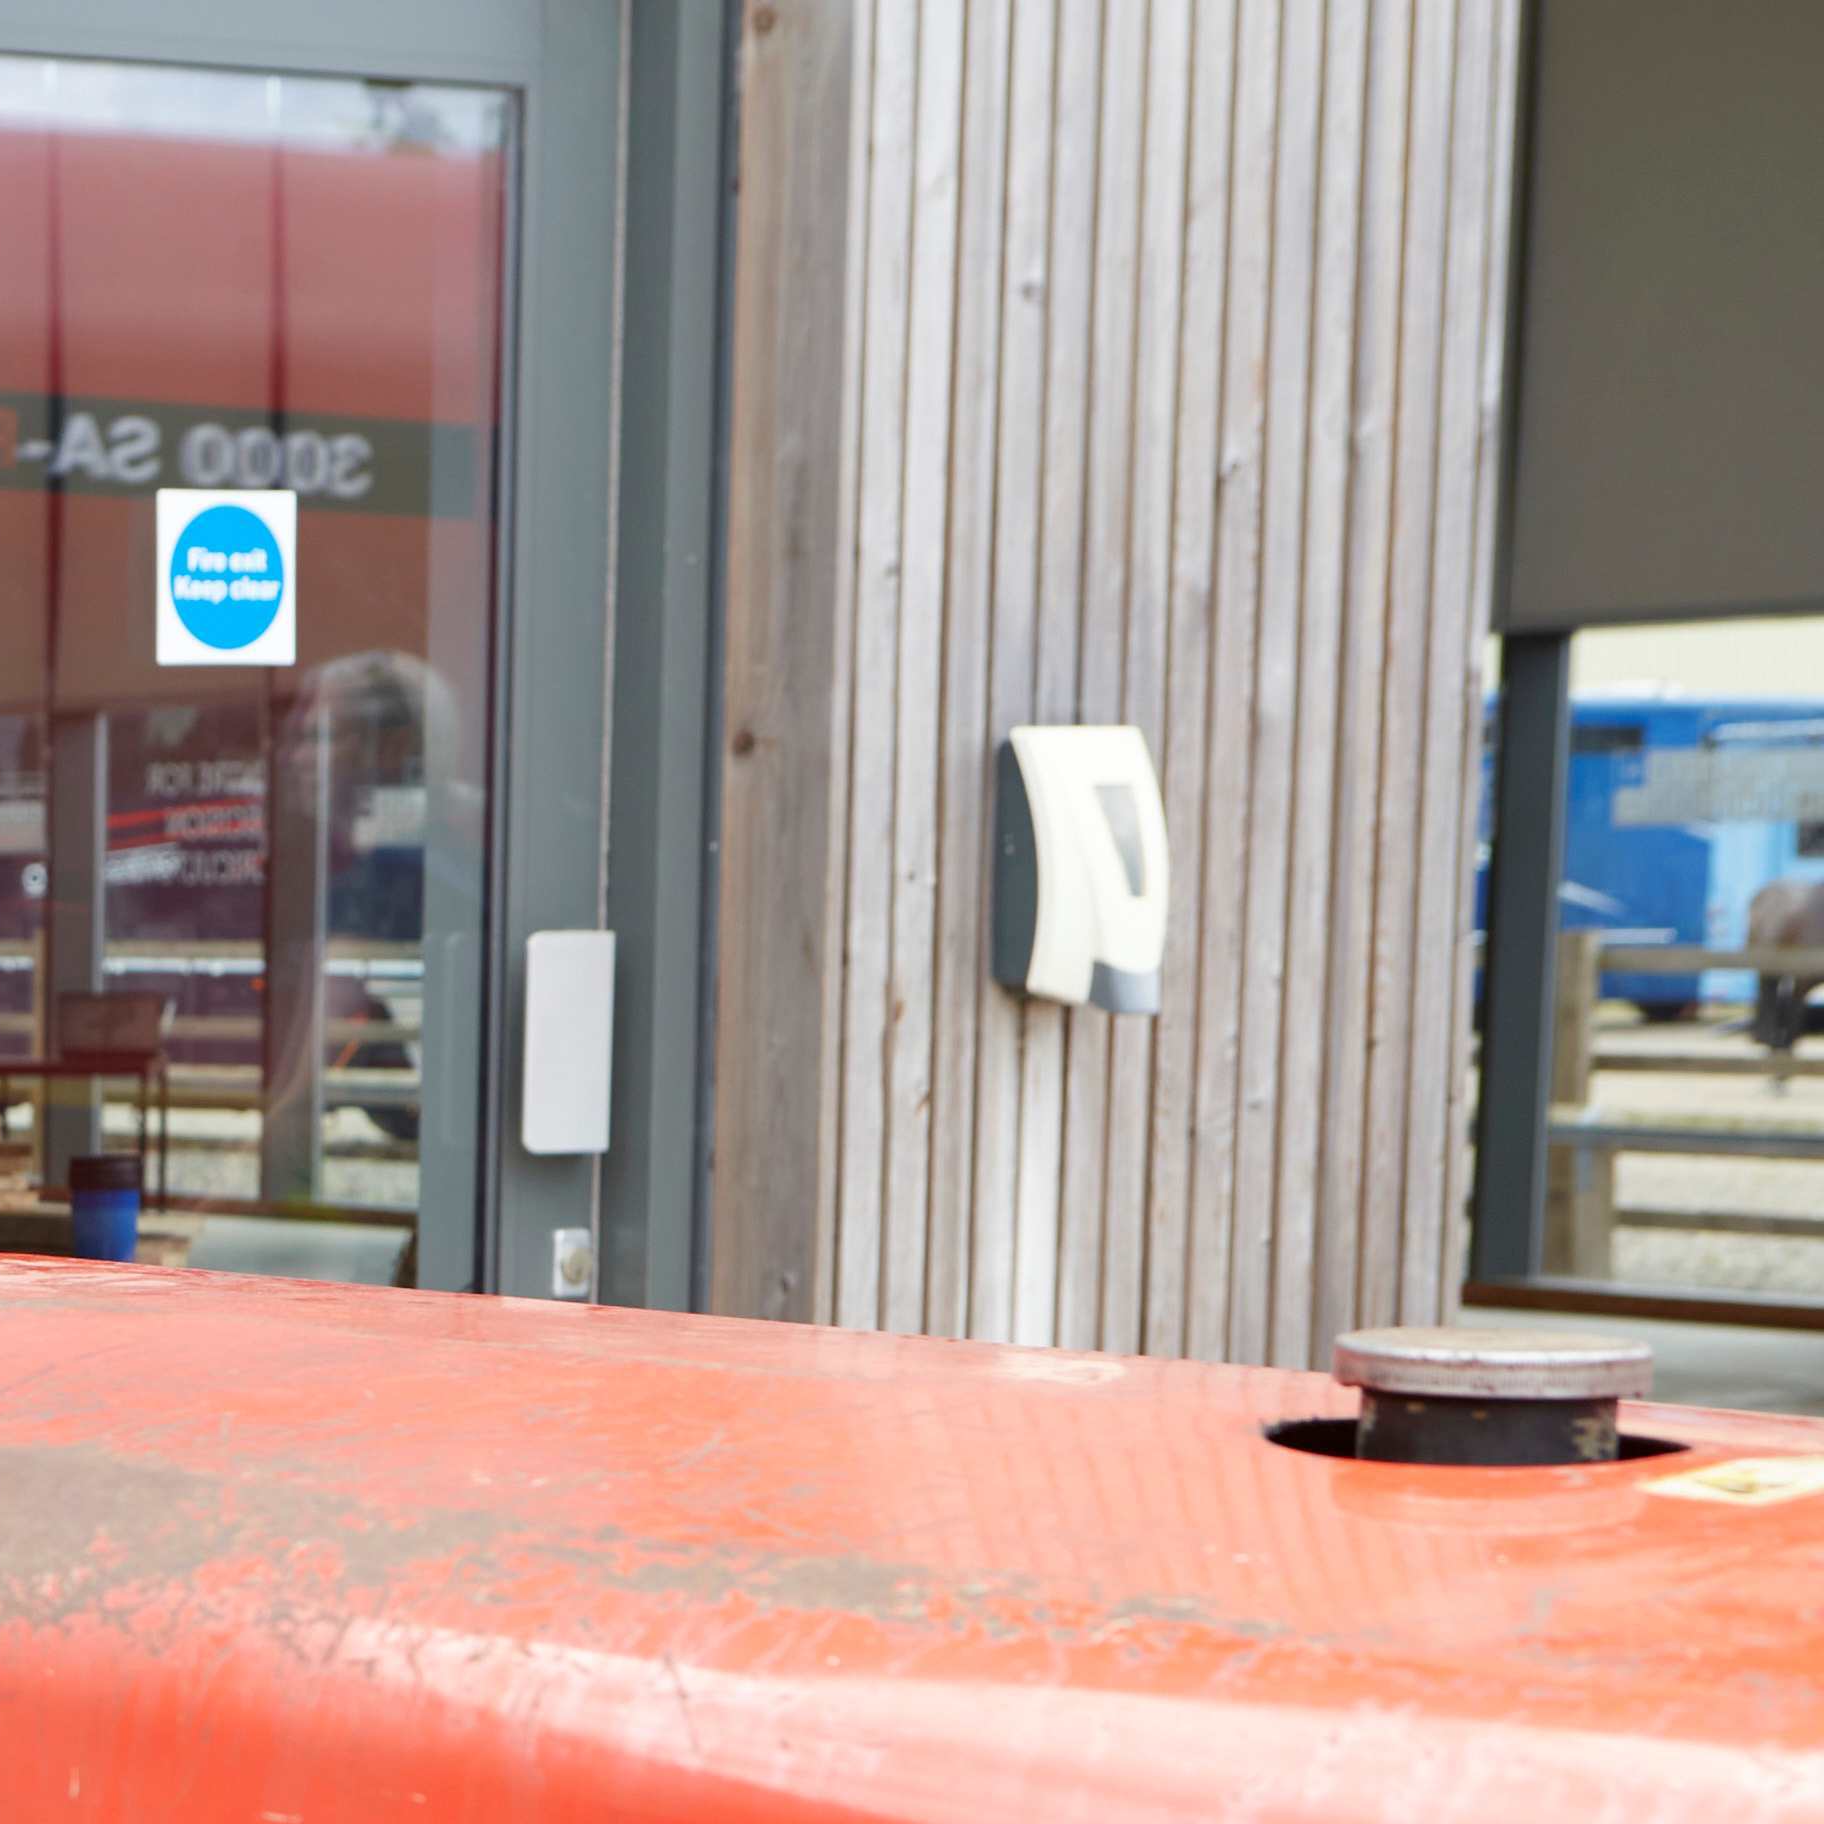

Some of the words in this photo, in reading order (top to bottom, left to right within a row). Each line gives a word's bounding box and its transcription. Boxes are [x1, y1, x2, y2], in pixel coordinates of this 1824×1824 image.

[186, 546, 228, 573] Fire
[228, 547, 269, 573] exit
[174, 574, 228, 605] Keep
[228, 574, 281, 601] clear
